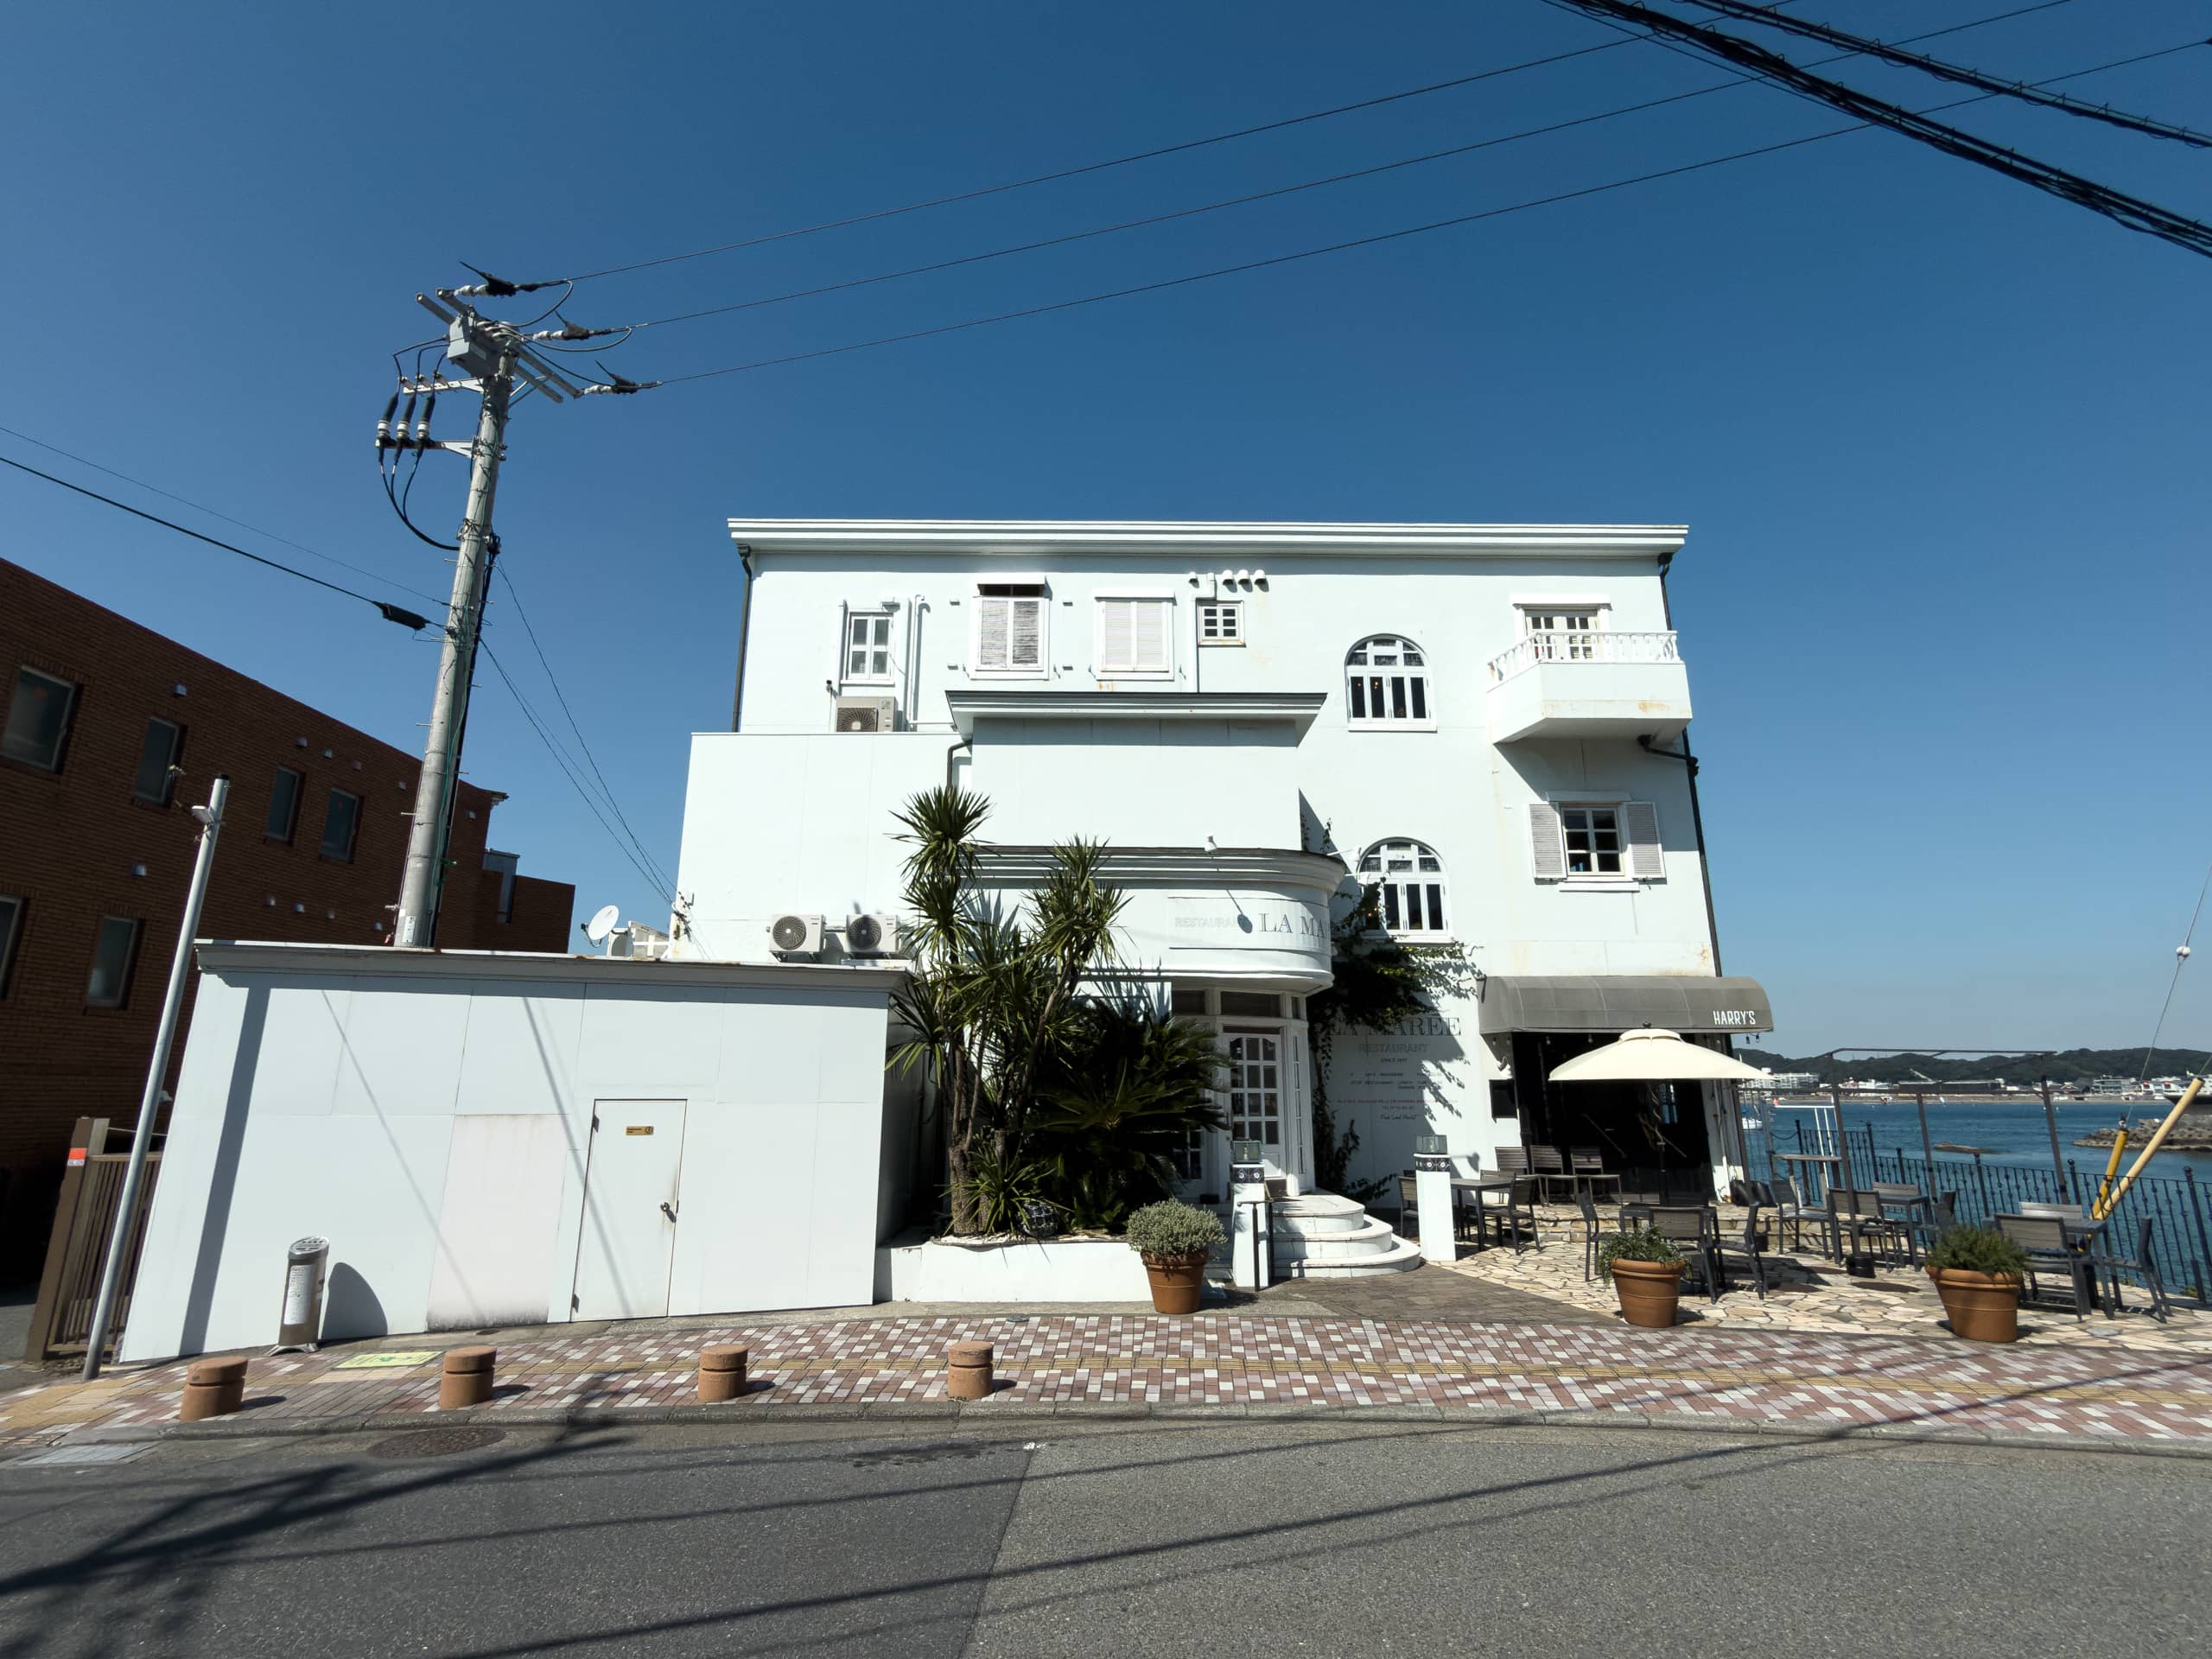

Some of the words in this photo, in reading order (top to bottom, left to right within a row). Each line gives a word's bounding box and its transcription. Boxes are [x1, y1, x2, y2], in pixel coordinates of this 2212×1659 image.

[1174, 917, 1245, 928] RESTAURA
[1258, 913, 1294, 934] LA
[1300, 916, 1329, 939] MA
[1713, 1010, 1756, 1025] HARRY'S
